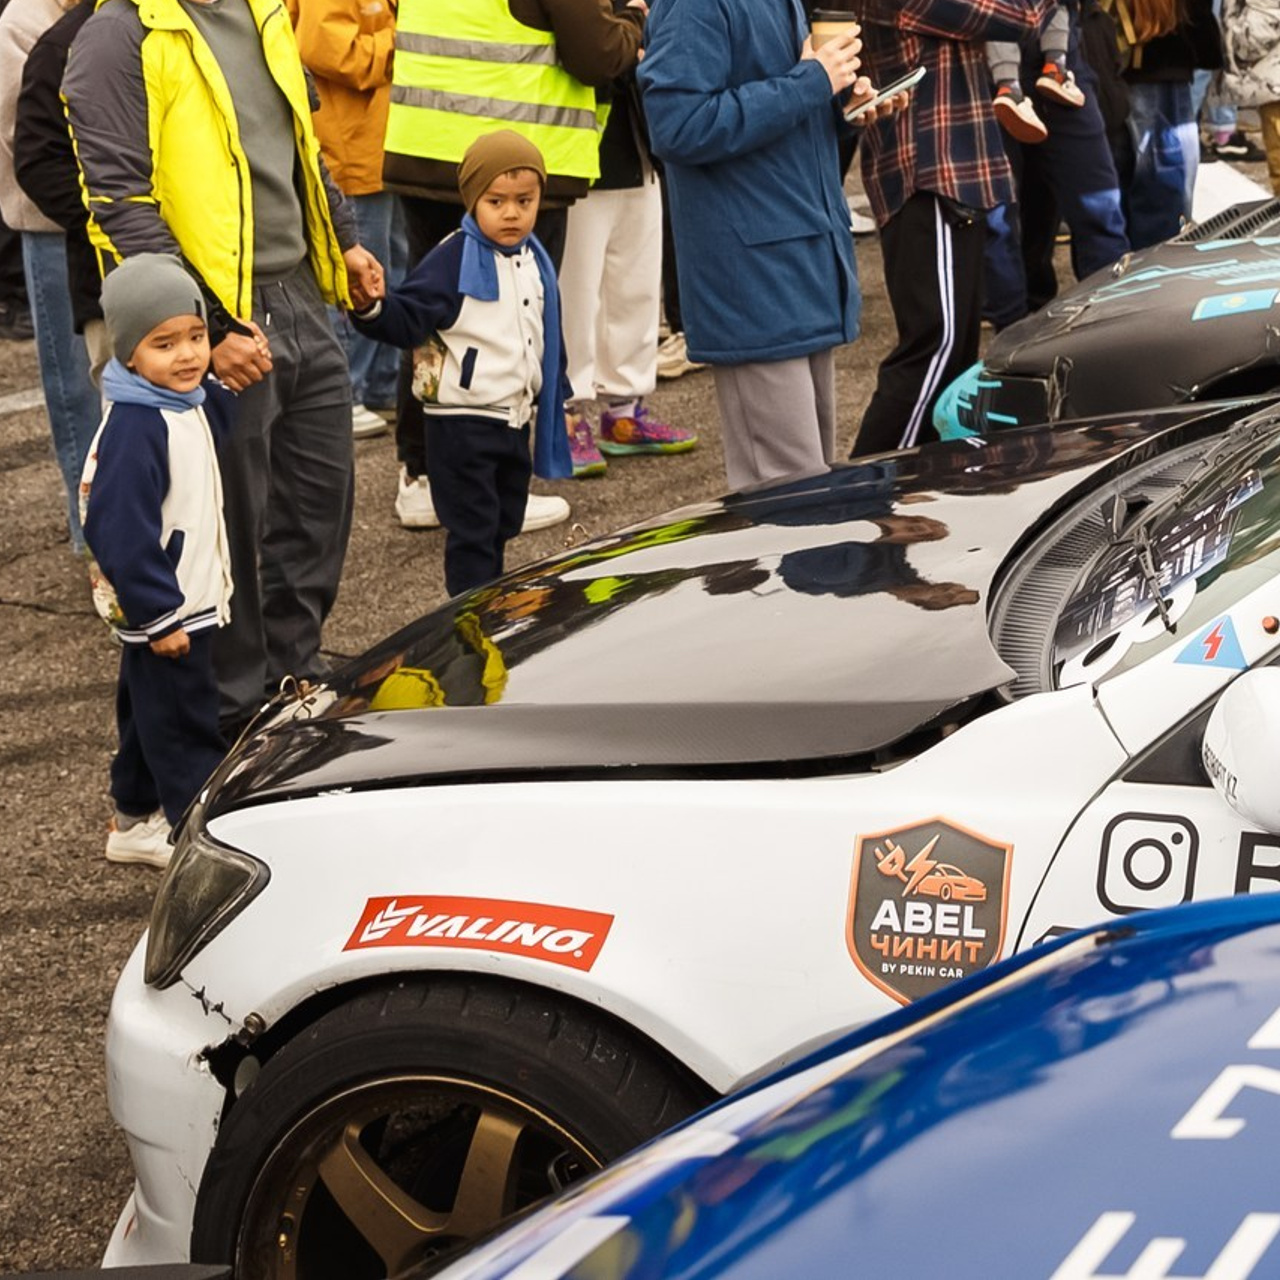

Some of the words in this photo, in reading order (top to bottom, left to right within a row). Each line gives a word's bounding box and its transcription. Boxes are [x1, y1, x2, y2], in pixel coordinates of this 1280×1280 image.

[870, 899, 986, 939] ABEL
[870, 933, 984, 963] ЧИНИТ
[881, 963, 897, 974] BY
[900, 964, 936, 977] PEKIN
[939, 967, 964, 979] CAR
